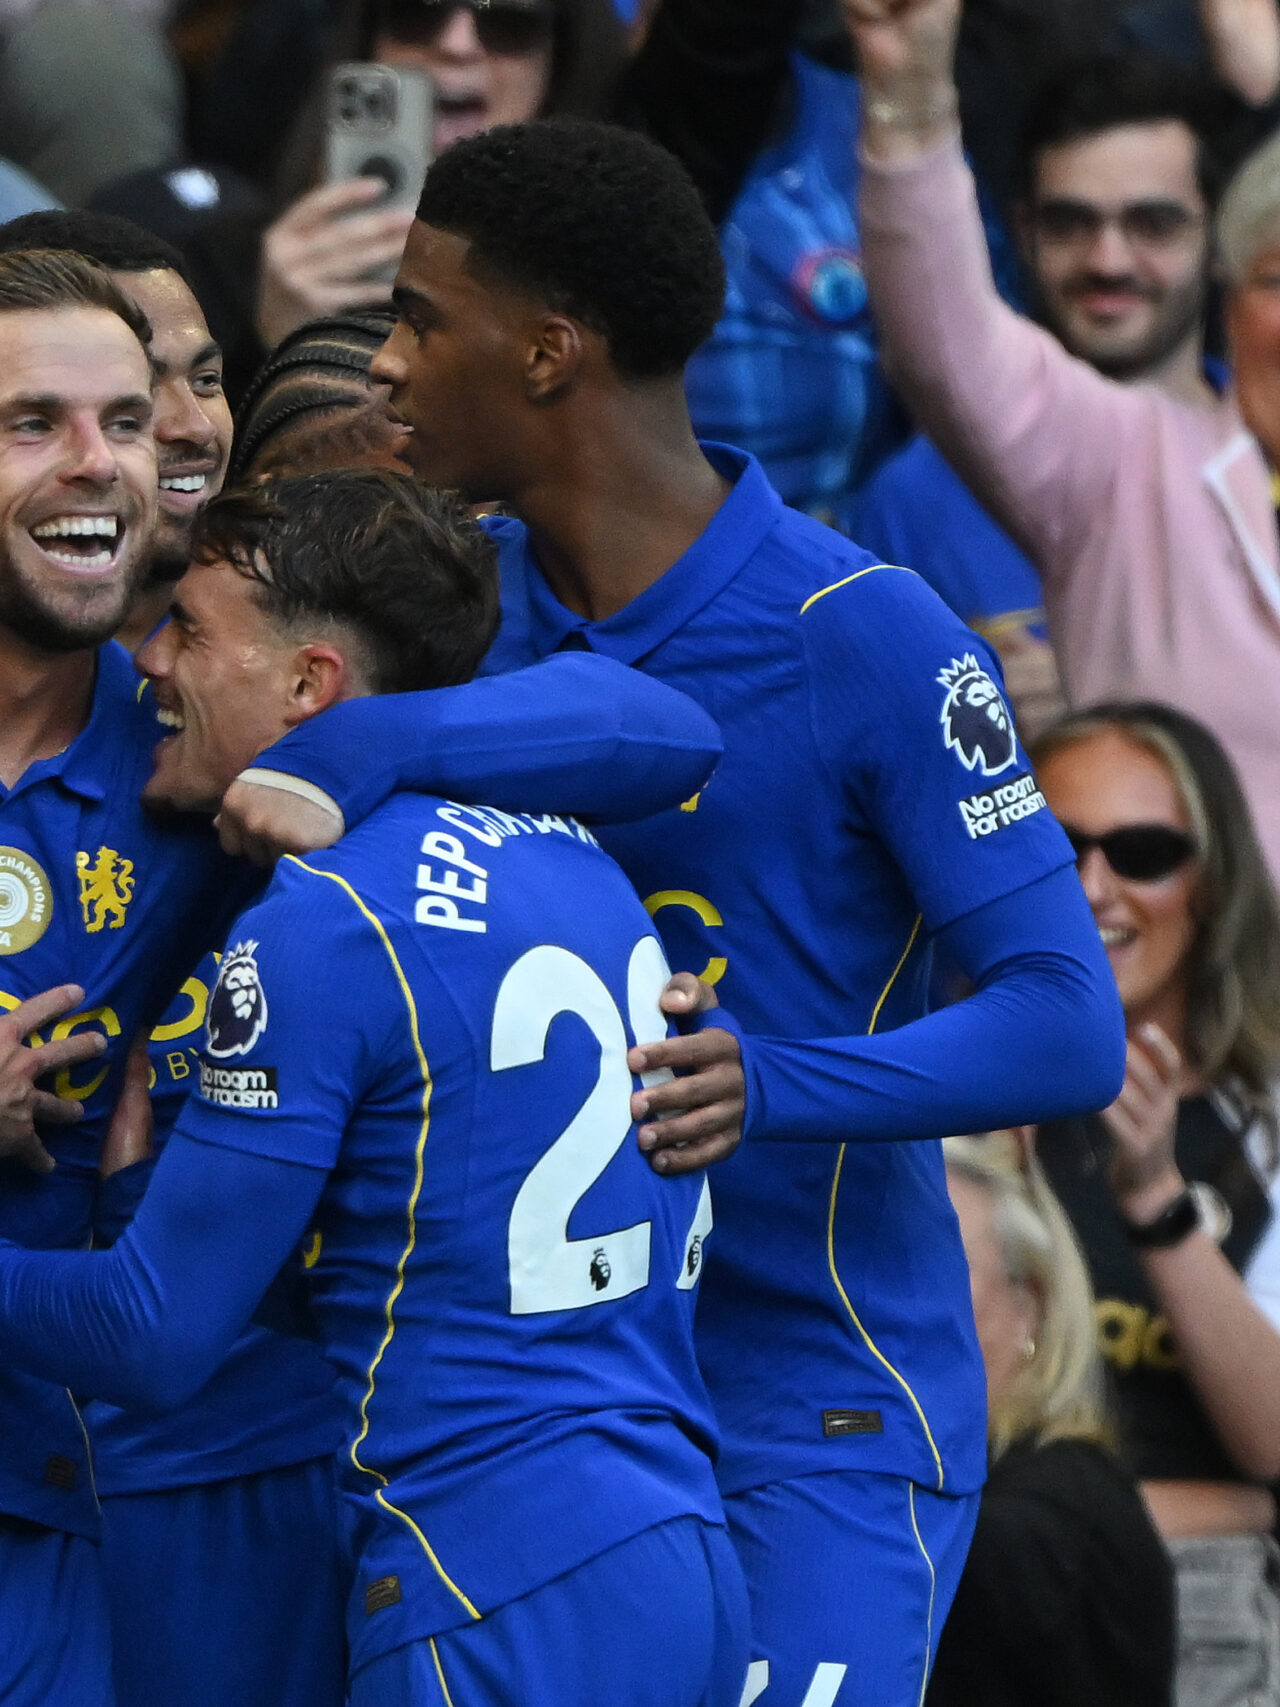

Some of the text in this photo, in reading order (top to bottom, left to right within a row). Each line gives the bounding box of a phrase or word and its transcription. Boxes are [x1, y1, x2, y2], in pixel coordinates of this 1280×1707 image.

[959, 775, 1036, 822] No room
[966, 791, 1048, 839] for racism
[415, 831, 488, 933] PEP
[213, 1070, 267, 1090] room
[213, 1089, 279, 1109] racism
